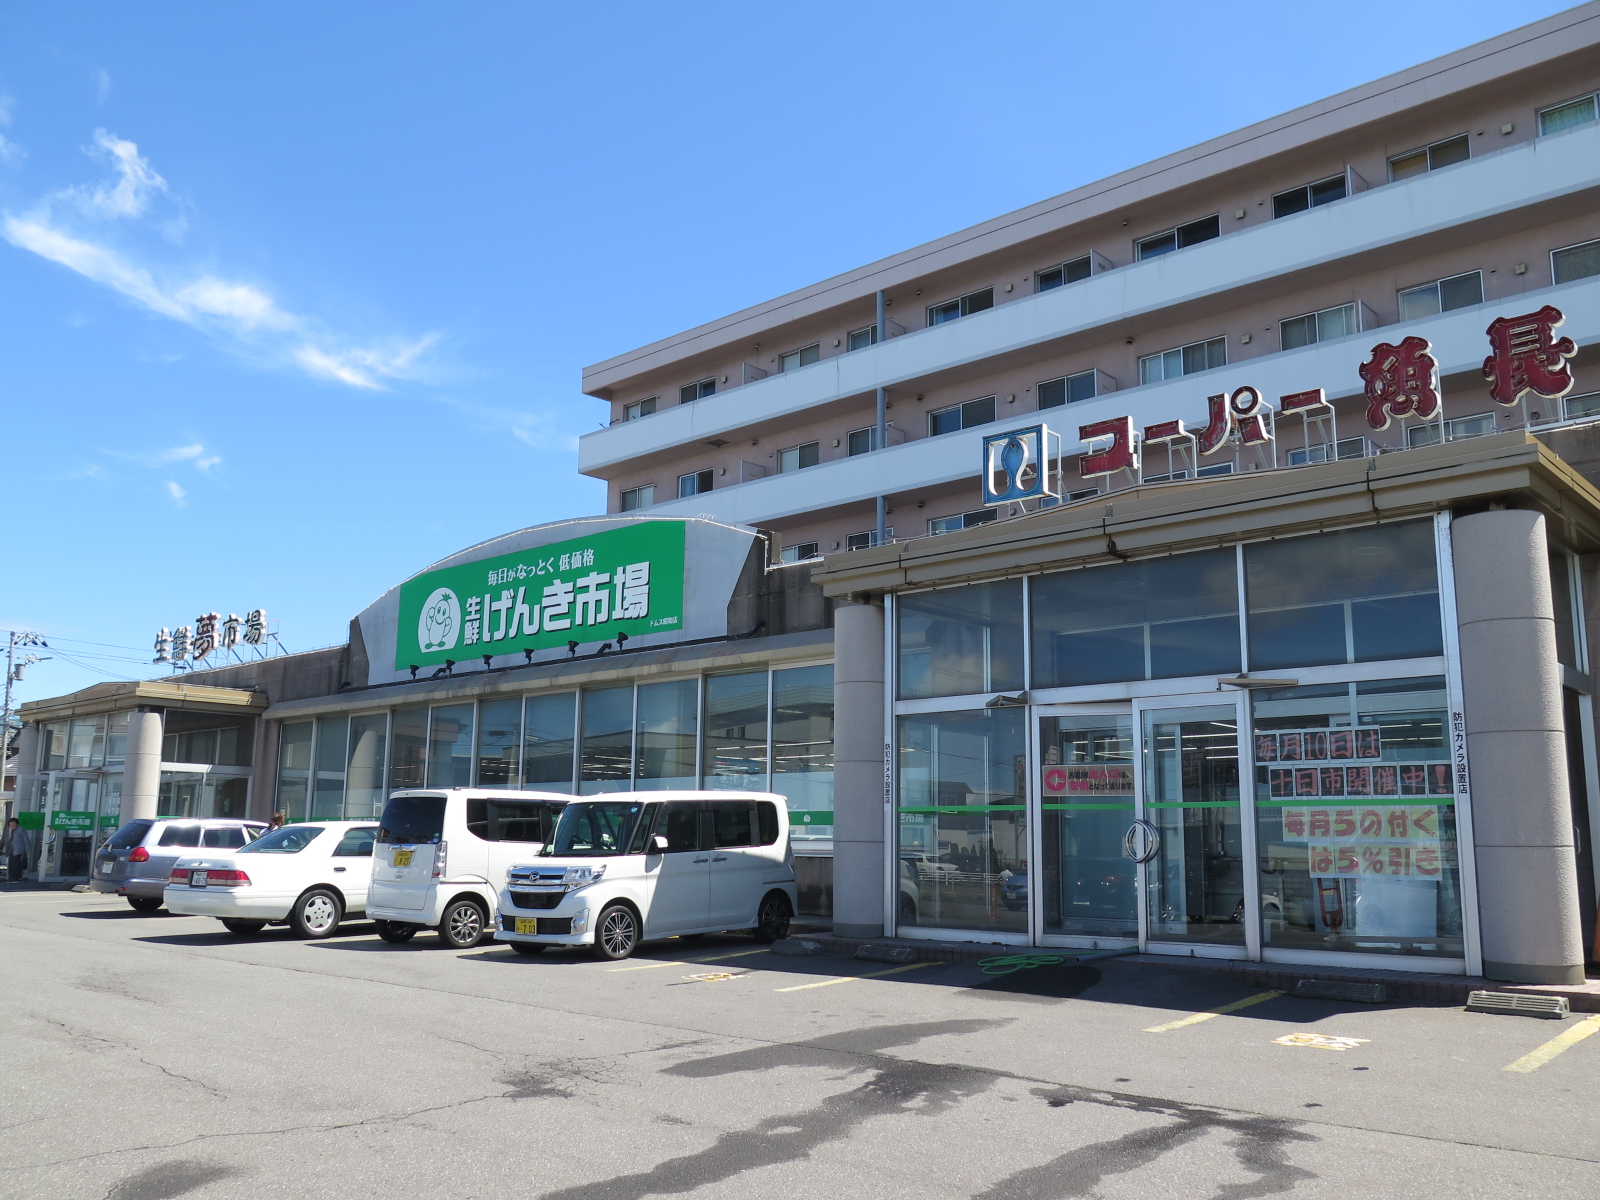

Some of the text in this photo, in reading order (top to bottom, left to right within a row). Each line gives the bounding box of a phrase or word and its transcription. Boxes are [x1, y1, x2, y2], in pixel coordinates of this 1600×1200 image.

[488, 549, 594, 586] 毎日がなっとく 低価格
[464, 596, 482, 646] 生鮮
[483, 561, 650, 643] げんき市場
[1256, 730, 1380, 762] 毎月10日は
[1453, 711, 1468, 794] 防犯カメラ設置店
[1284, 809, 1436, 838] 毎月5の付く
